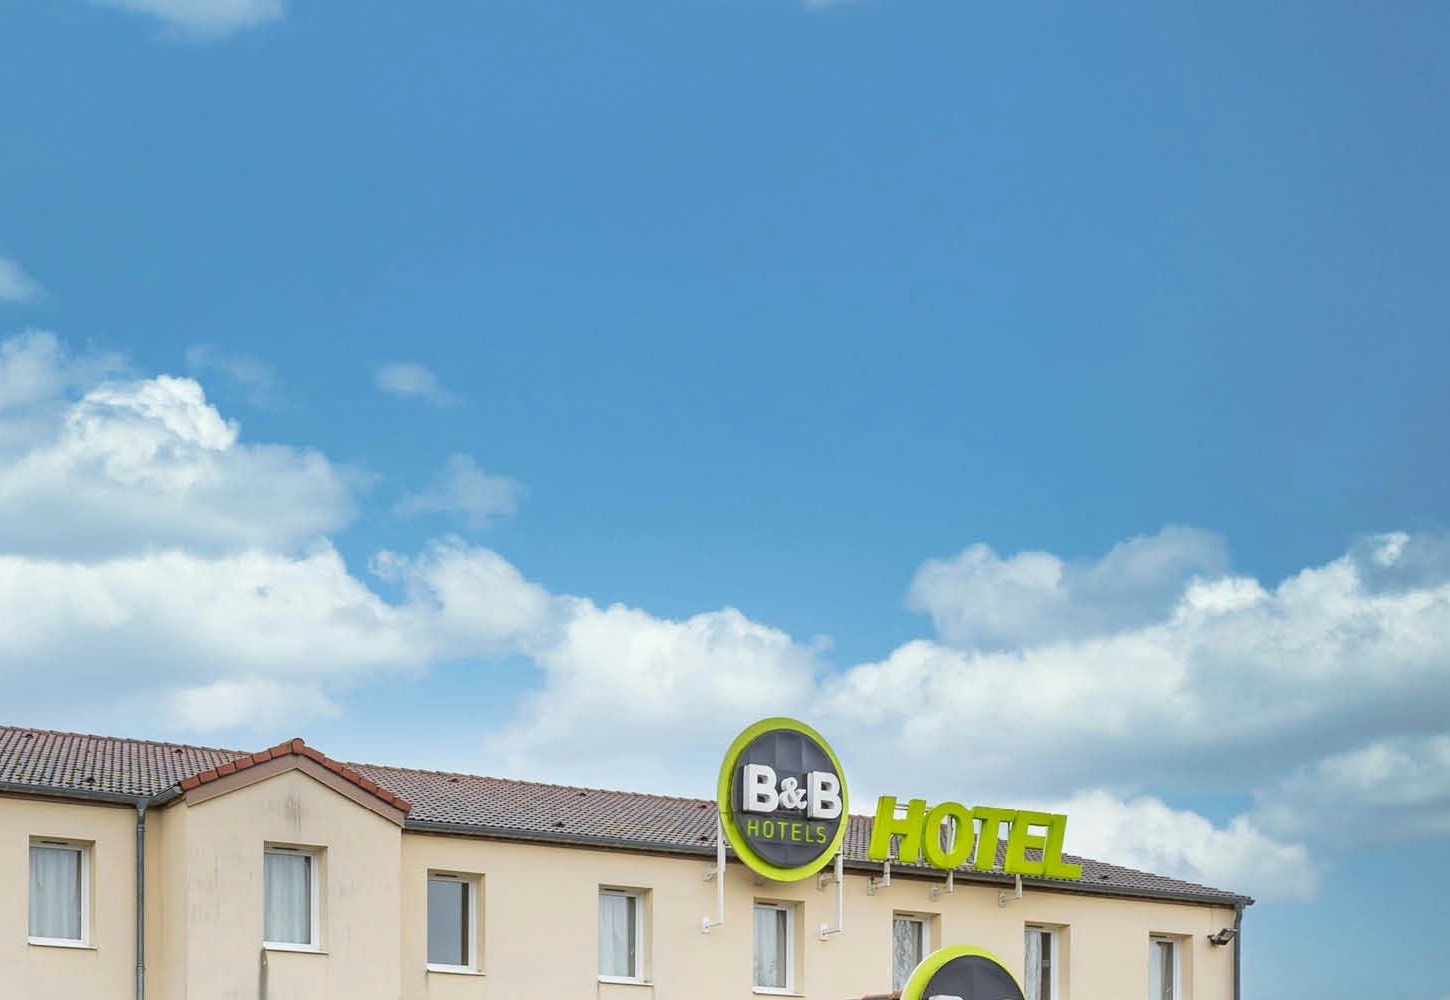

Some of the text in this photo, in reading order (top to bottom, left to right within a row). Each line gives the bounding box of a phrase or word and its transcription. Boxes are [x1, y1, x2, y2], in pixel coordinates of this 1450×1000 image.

[743, 763, 842, 819] B&B
[747, 819, 827, 845] HOTELS
[868, 796, 1082, 879] HOTEL
